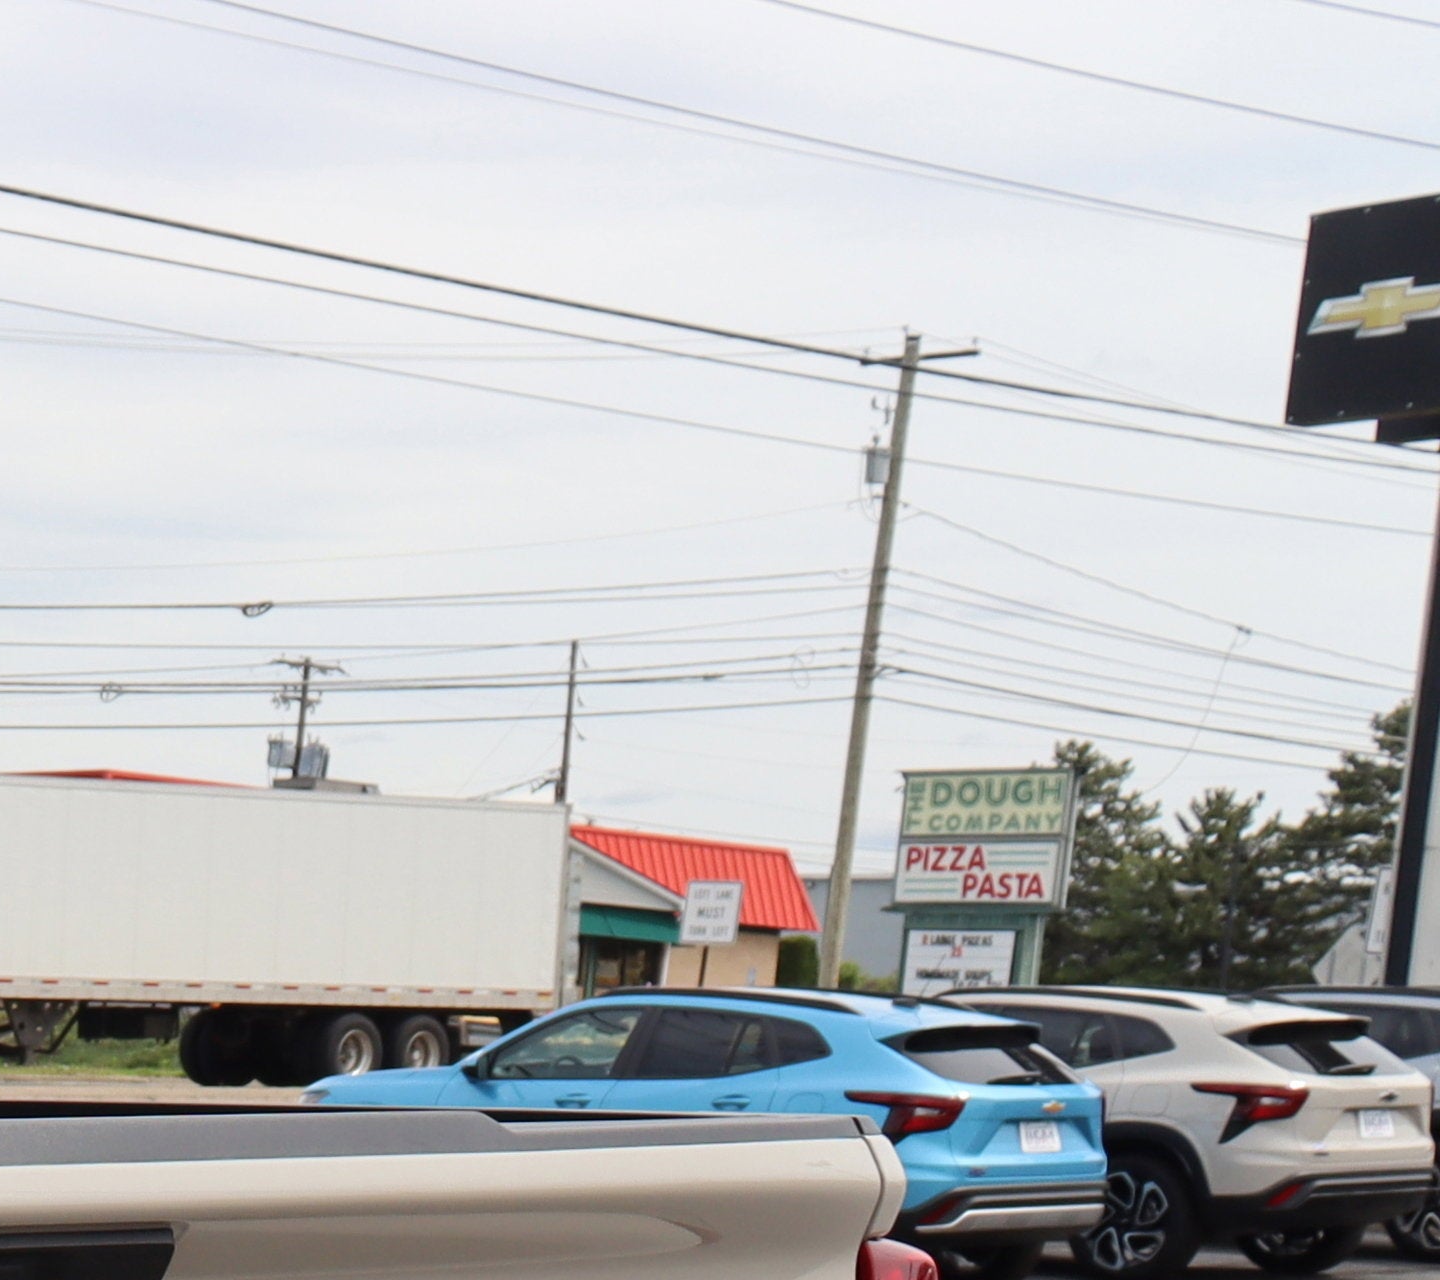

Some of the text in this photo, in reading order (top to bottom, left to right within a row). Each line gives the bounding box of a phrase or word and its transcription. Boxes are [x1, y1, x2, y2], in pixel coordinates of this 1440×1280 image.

[931, 776, 1065, 807] DOUGH
[906, 780, 926, 830] THE
[928, 813, 1061, 832] COMPANY
[906, 845, 985, 871] PIZZA
[961, 872, 1045, 899] PASTA
[697, 905, 726, 919] MUST
